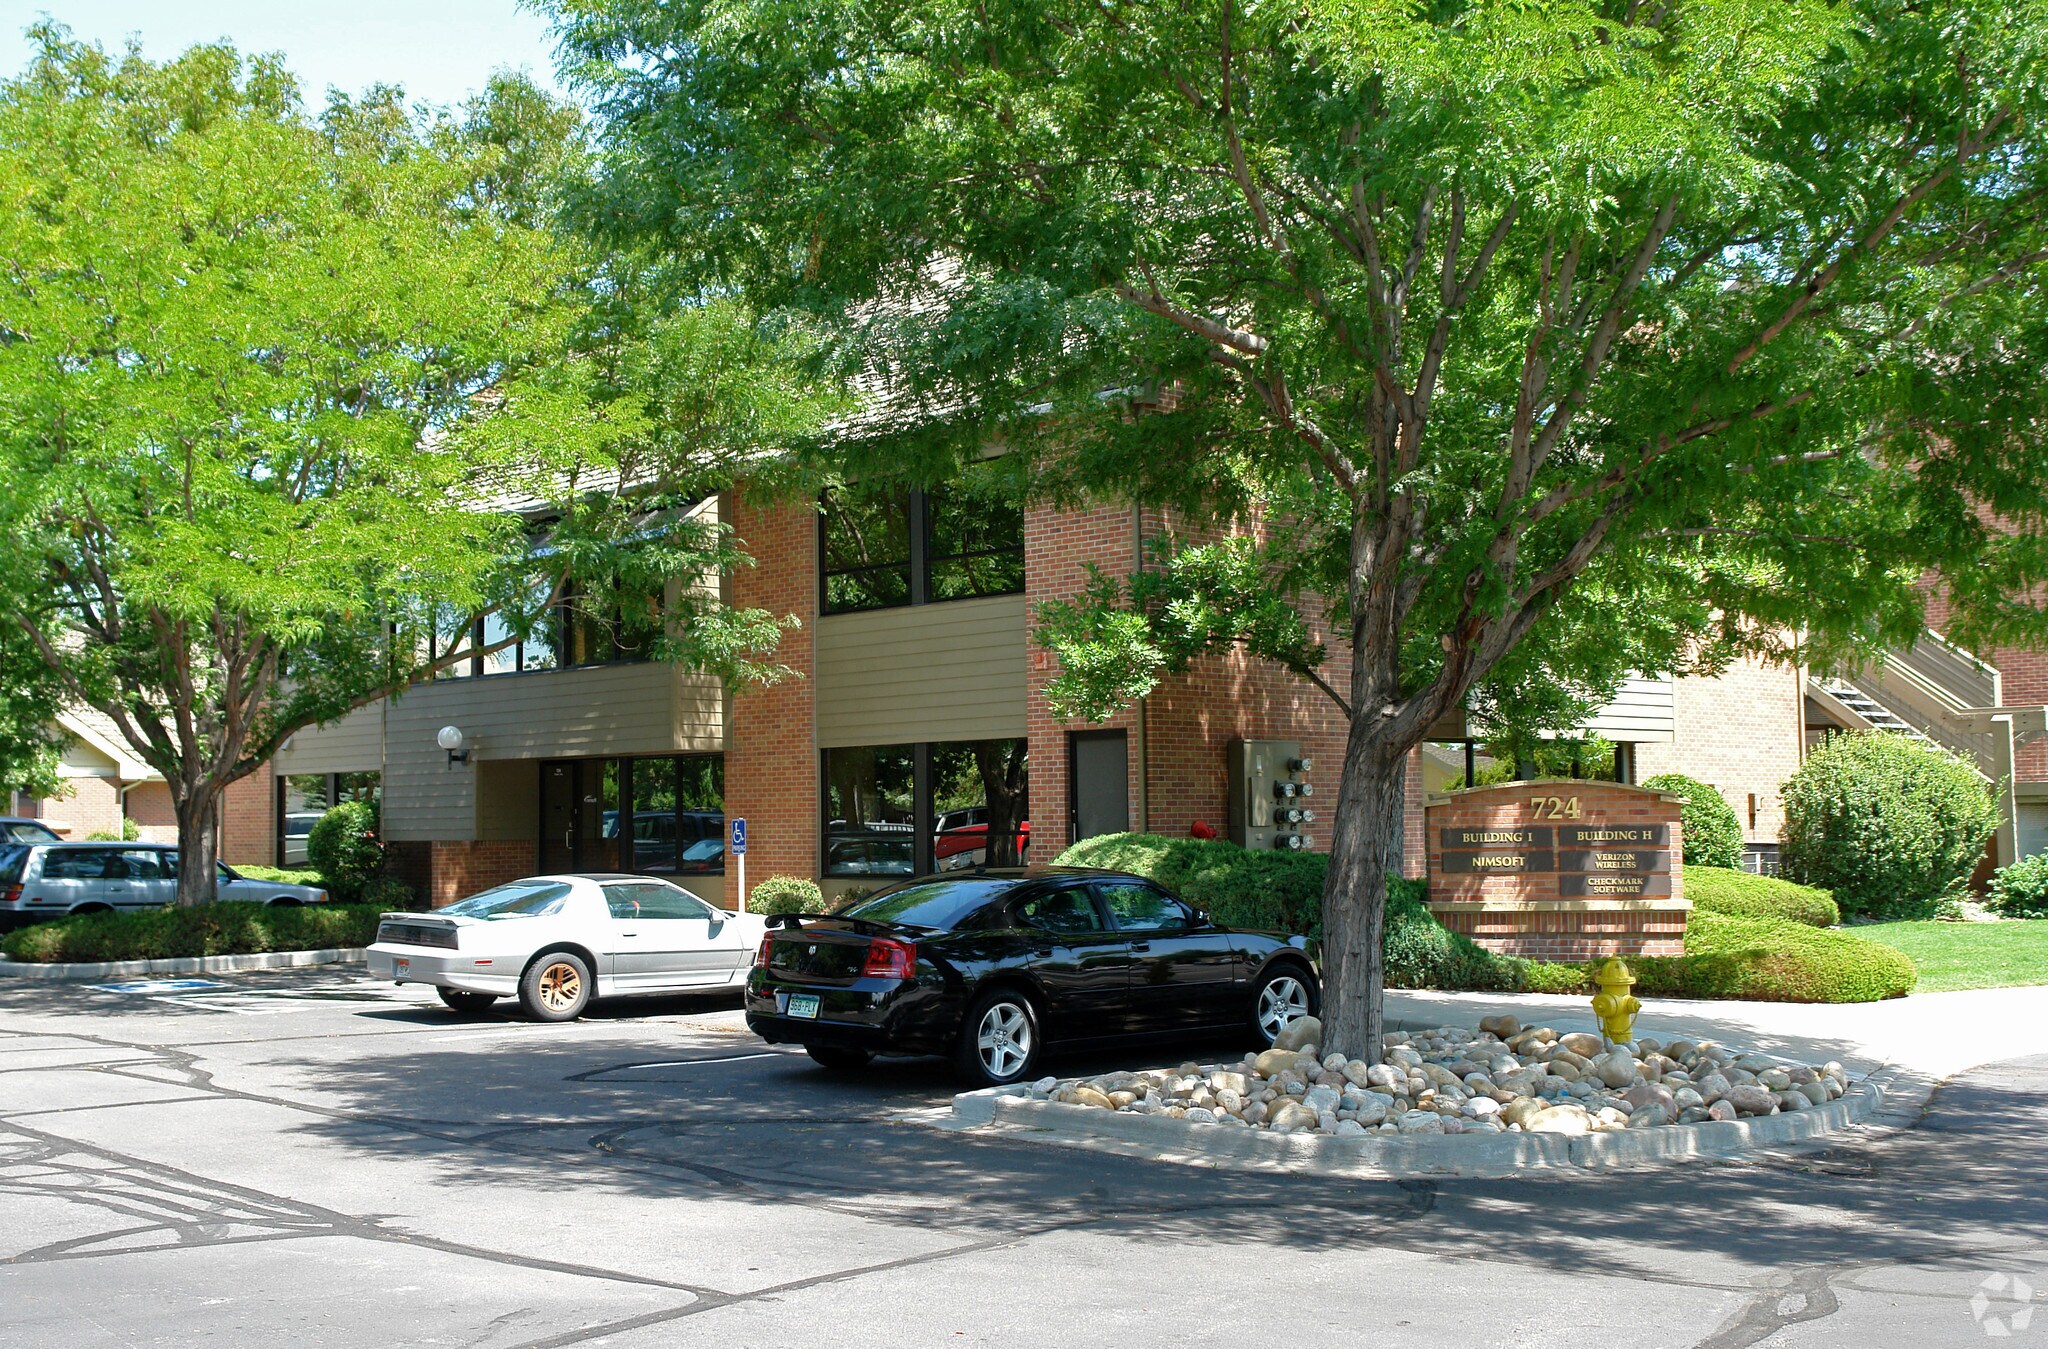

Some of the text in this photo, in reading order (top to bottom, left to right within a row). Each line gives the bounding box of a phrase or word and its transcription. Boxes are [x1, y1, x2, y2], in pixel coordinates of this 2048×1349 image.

[1530, 796, 1581, 819] 724
[1462, 832, 1533, 843] BUILDING I
[1576, 830, 1653, 841] BUILDING H
[1472, 856, 1525, 867] NIMSOFT
[1595, 853, 1635, 861] VERIZON
[1594, 861, 1637, 869] WIRELESS
[1587, 877, 1644, 885] CHECKMARK
